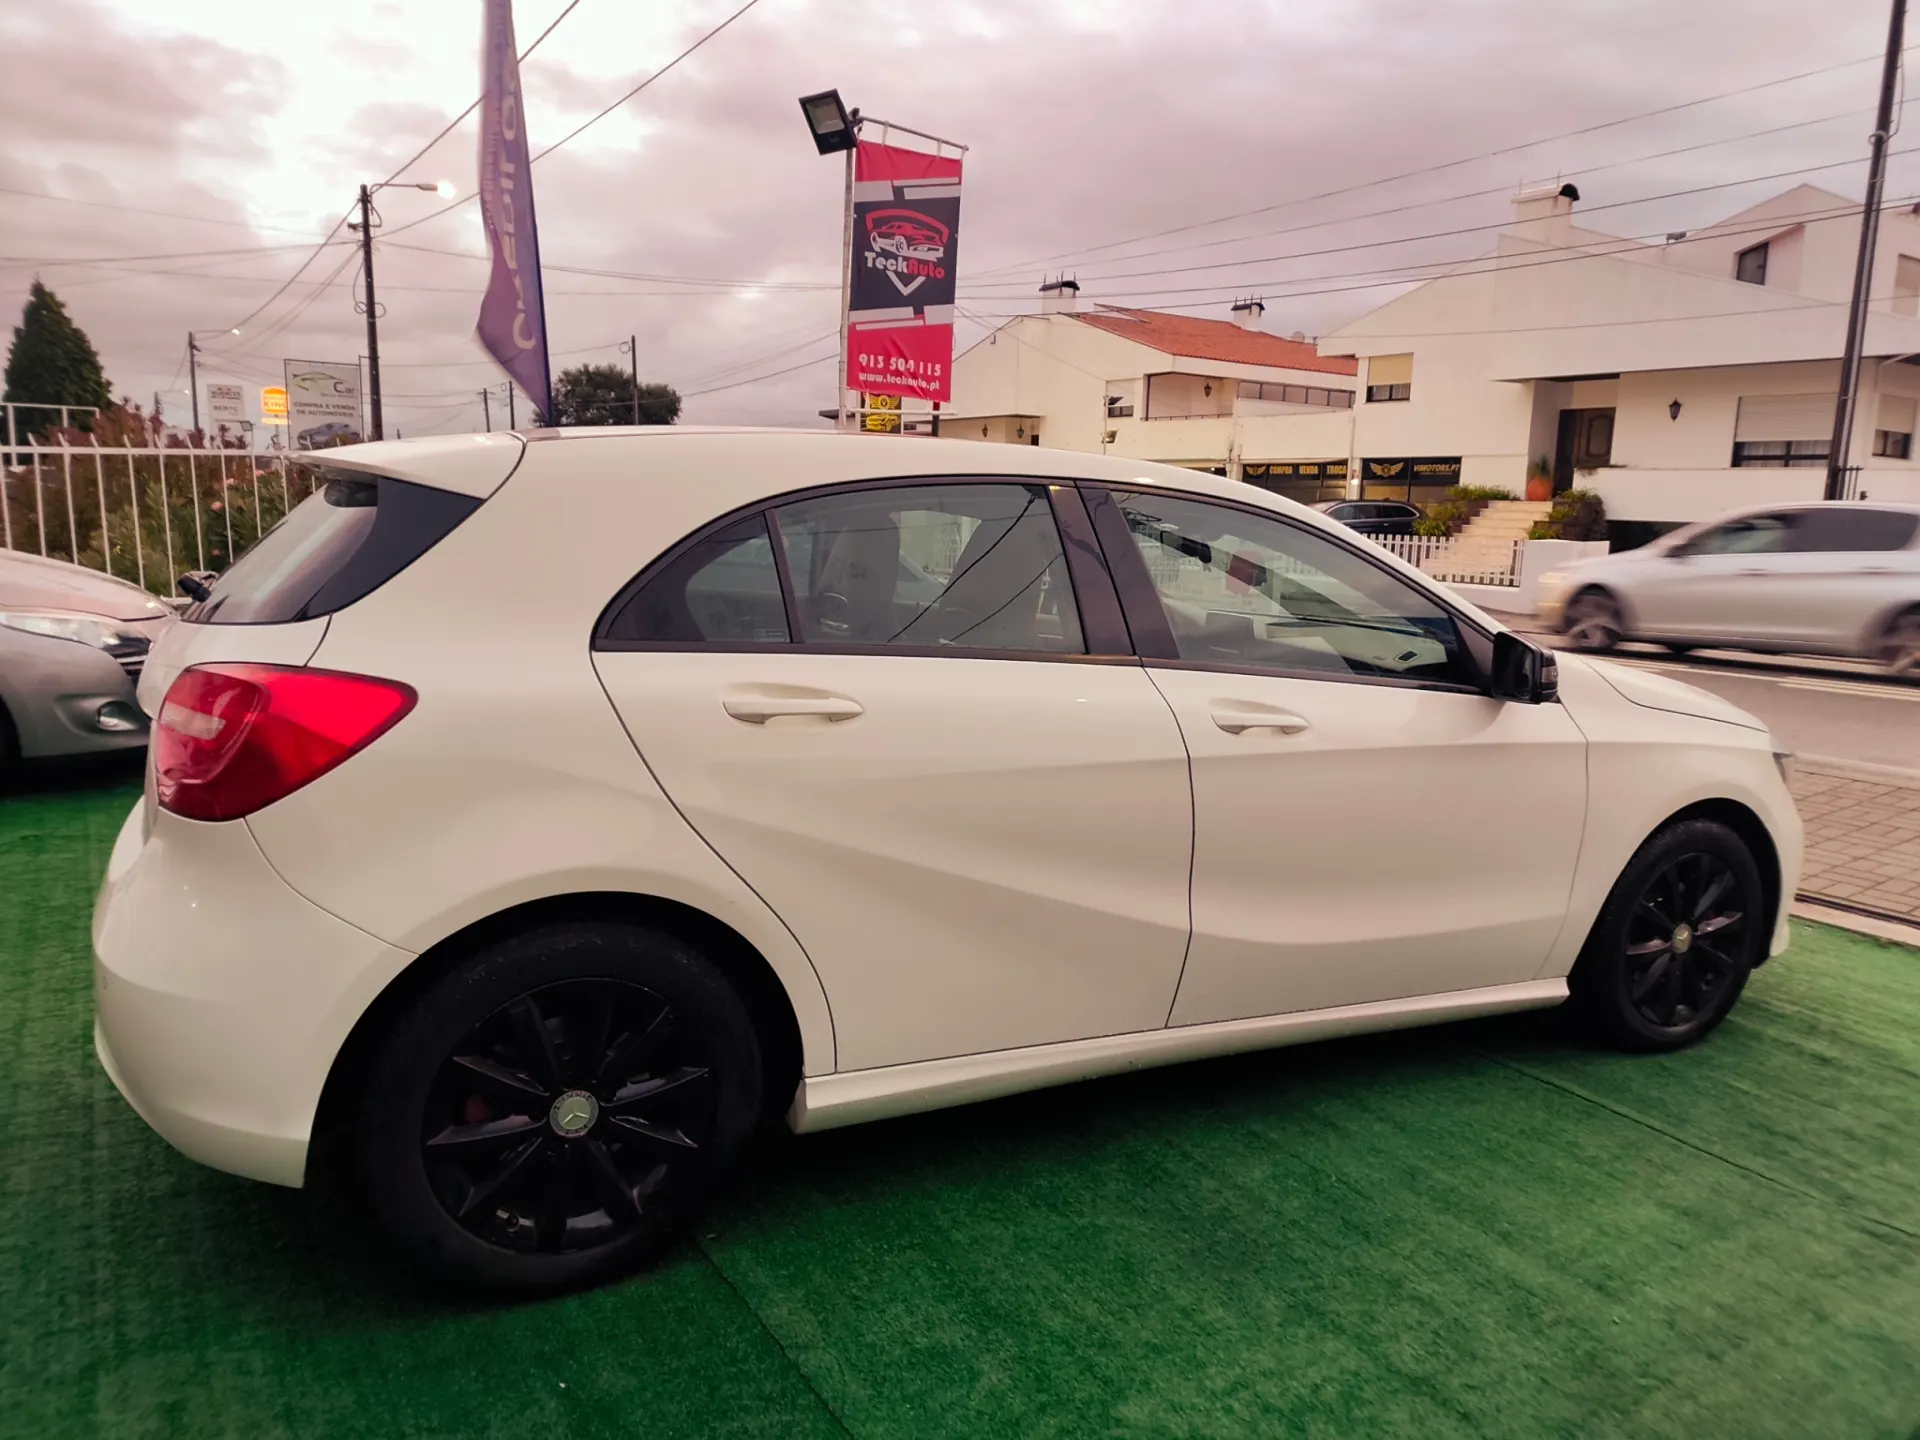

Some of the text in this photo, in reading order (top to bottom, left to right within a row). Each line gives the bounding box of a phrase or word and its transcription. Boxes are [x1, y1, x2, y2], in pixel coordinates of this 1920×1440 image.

[864, 251, 945, 279] TeckAuto
[859, 353, 941, 376] 913 504 115
[333, 381, 355, 394] Car
[859, 372, 940, 391] www.teckauto.pt
[293, 401, 324, 409] COMPRA
